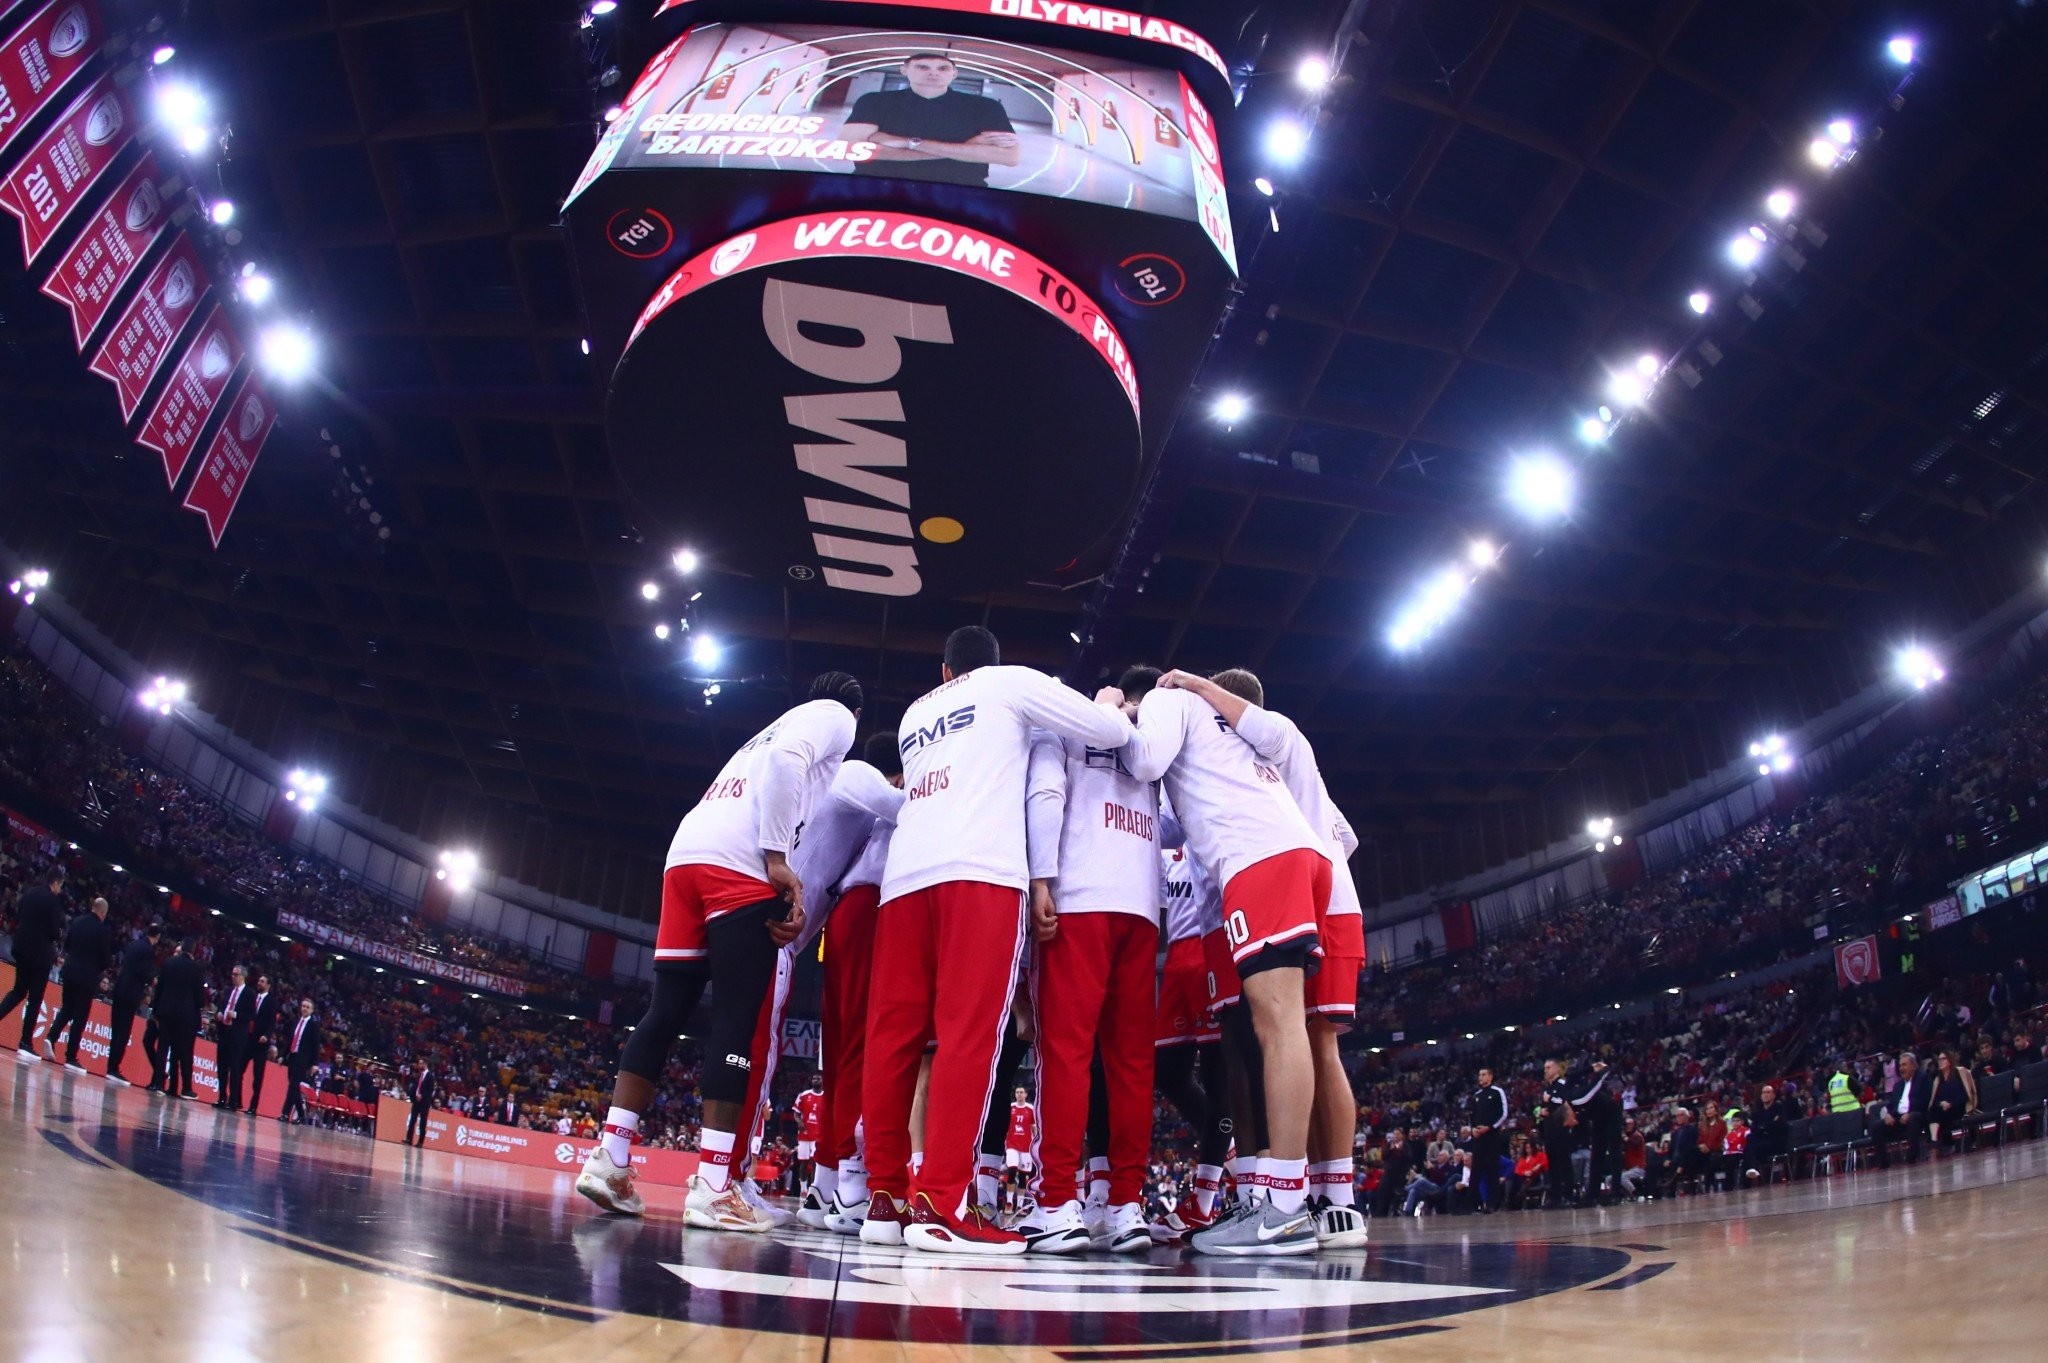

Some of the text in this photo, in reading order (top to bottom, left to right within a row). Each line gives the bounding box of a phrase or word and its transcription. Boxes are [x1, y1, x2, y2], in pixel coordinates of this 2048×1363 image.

[18, 44, 43, 94] CHAMPIONS
[28, 37, 51, 84] EUROPEAN
[639, 112, 824, 135] GEORGIOS
[57, 137, 81, 182] EUROPEAN
[645, 135, 877, 162] BARTZOKAS
[49, 145, 75, 193] CHAMPIONS
[23, 163, 59, 222] 2013
[617, 217, 656, 248] TGI
[81, 247, 95, 270] 1976
[89, 237, 116, 284] 1949 1960
[794, 217, 1016, 278] WELCOME
[1036, 268, 1077, 314] TO
[74, 259, 102, 304] 1993 1994
[74, 281, 88, 303] 1995
[1133, 267, 1166, 300] TGI
[118, 336, 145, 380] 2016 2022
[125, 326, 151, 369] 2012 2015
[118, 358, 131, 379] 2023
[762, 277, 964, 597] bwin
[1104, 802, 1153, 842] PIRAEUS
[467, 1137, 511, 1153] EuroLeague
[468, 1129, 528, 1147] TURKISH AIRLINES
[1271, 1180, 1297, 1190] GSA
[1324, 1174, 1348, 1183] GSA
